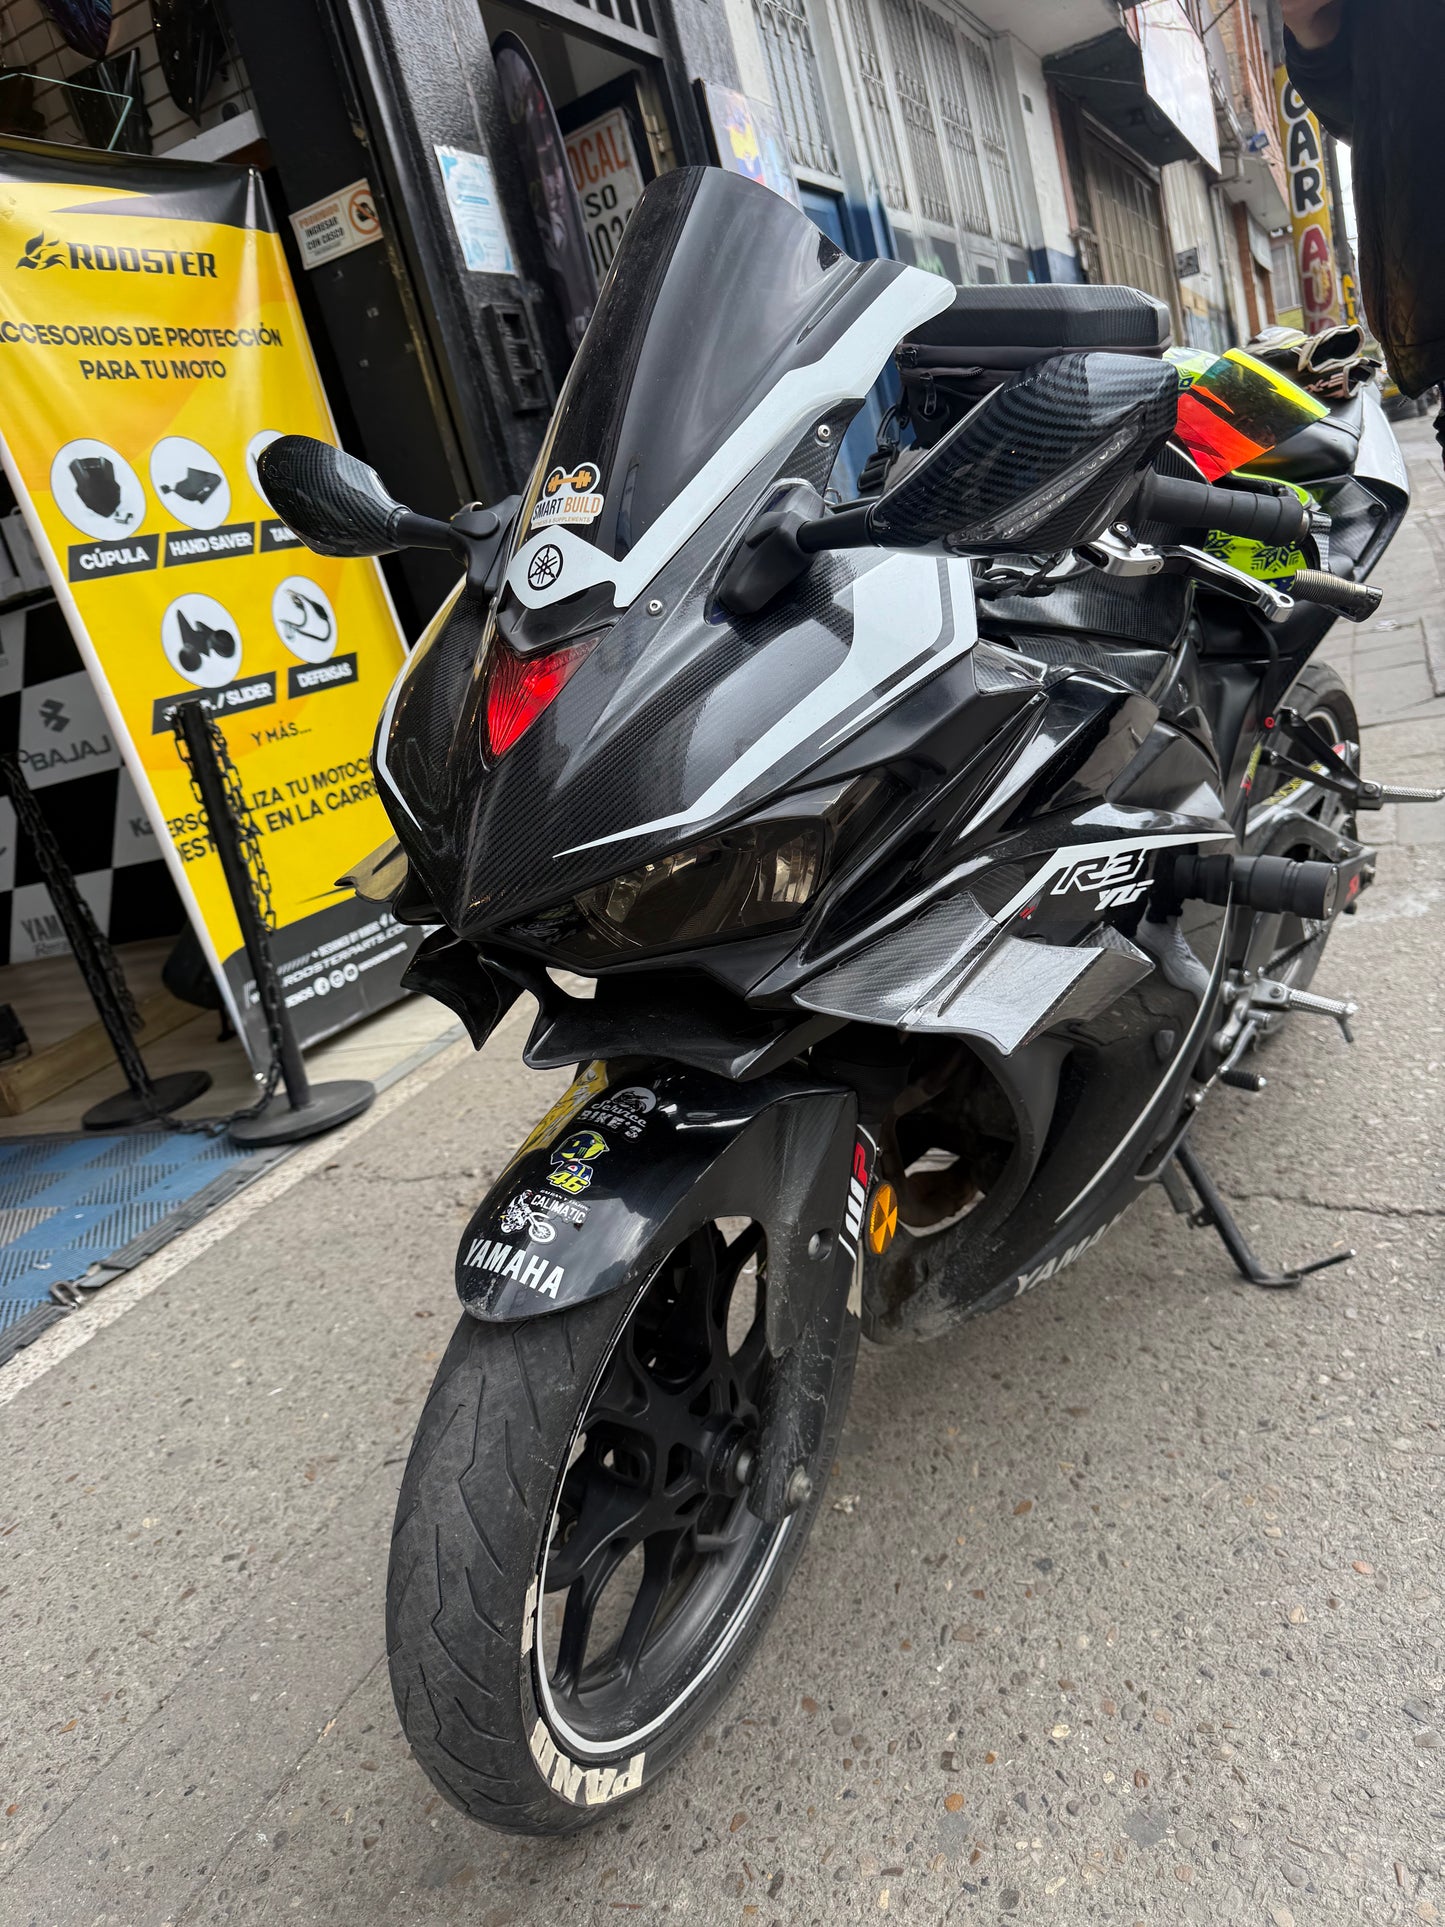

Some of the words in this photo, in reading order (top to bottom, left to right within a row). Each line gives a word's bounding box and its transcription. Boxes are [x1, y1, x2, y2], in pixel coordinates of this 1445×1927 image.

[66, 242, 218, 278] ROOSTER
[133, 326, 163, 346] DE
[164, 322, 283, 347] PROTECCIÓN
[79, 360, 139, 380] PARA
[141, 360, 169, 380] TU
[170, 360, 227, 379] MOTO
[532, 498, 564, 520] SMART
[563, 496, 601, 514] BUILD
[168, 537, 210, 557] HAND
[208, 532, 254, 551] SAVER
[79, 547, 151, 570] CÚPULA
[296, 662, 353, 688] DEFENSAS
[225, 682, 274, 706] SLIDER
[252, 731, 263, 747] Y
[29, 734, 112, 772] BAJAJ
[286, 777, 309, 798] TU
[265, 807, 294, 832] EN
[296, 801, 324, 823] LA
[1050, 849, 1146, 895] R3
[591, 1099, 647, 1128] Service
[547, 1171, 589, 1194] 46
[530, 1194, 586, 1224] CALIMATIC
[462, 1237, 566, 1300] YAMAHA
